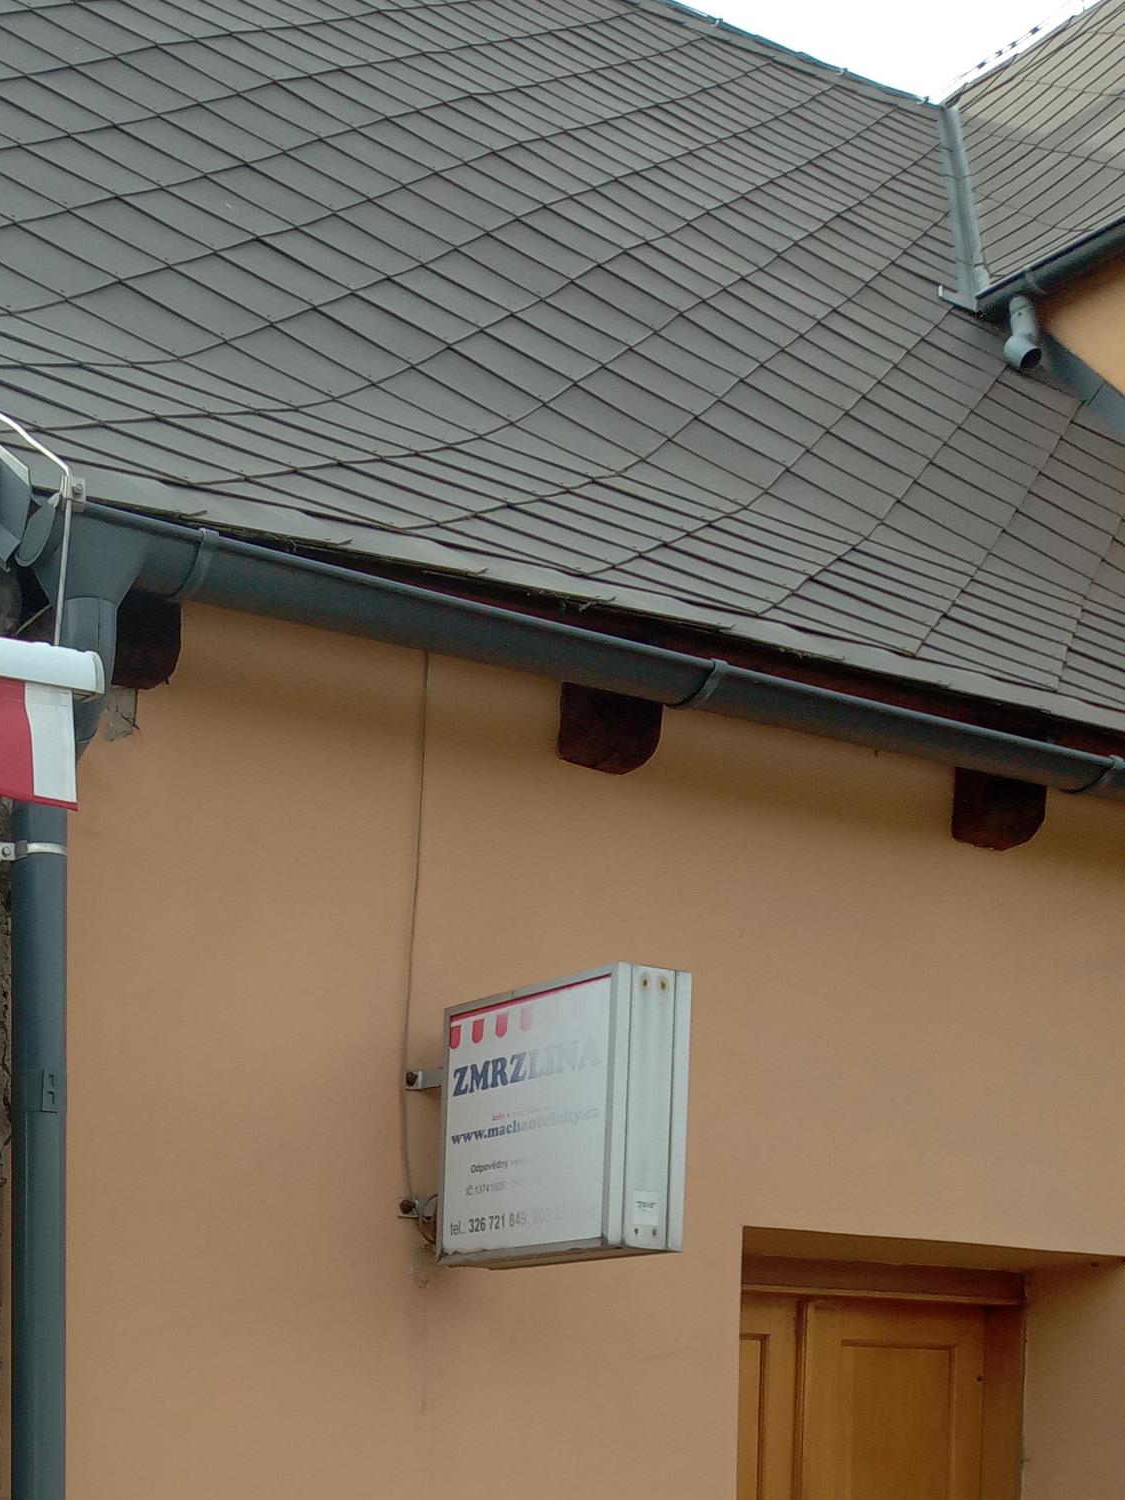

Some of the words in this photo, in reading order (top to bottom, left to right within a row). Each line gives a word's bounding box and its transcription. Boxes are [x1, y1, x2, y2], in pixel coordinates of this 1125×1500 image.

[452, 1039, 602, 1098] ZMRZLINA
[468, 1217, 486, 1233] 326
[488, 1213, 506, 1231] 721
